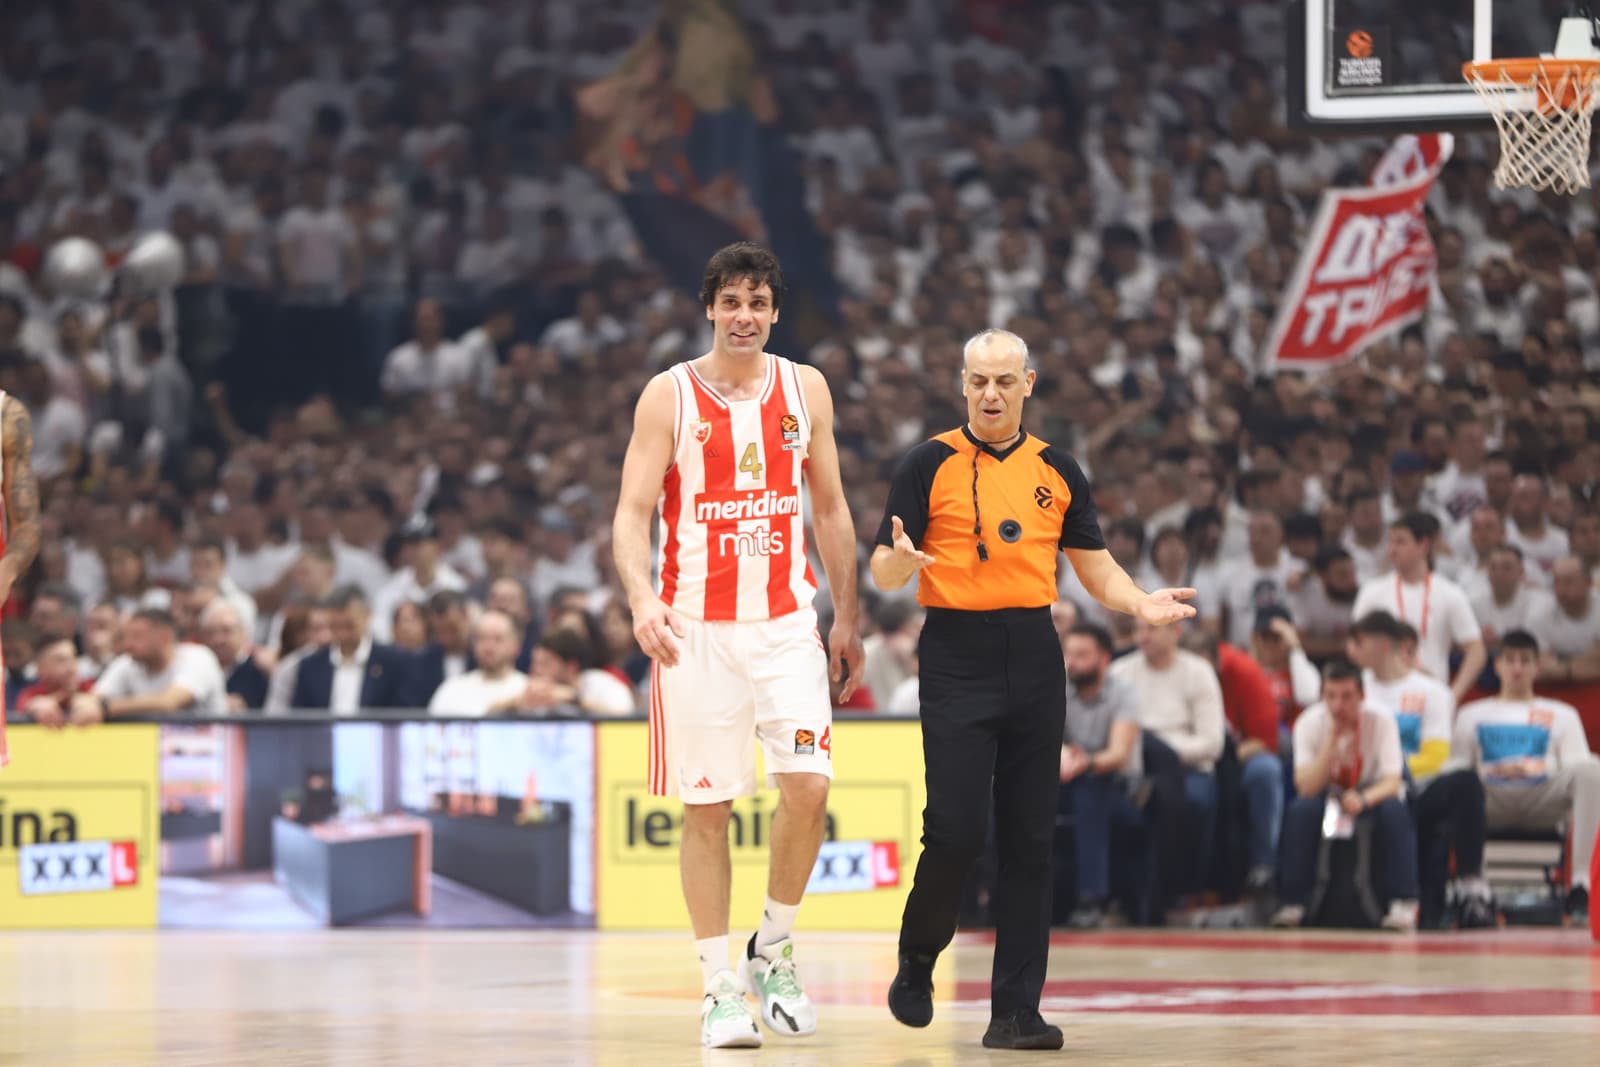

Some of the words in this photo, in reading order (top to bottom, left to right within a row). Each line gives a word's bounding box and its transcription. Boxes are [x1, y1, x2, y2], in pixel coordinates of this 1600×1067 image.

[738, 442, 763, 480] 4
[696, 490, 798, 521] meridian
[719, 525, 785, 557] mts
